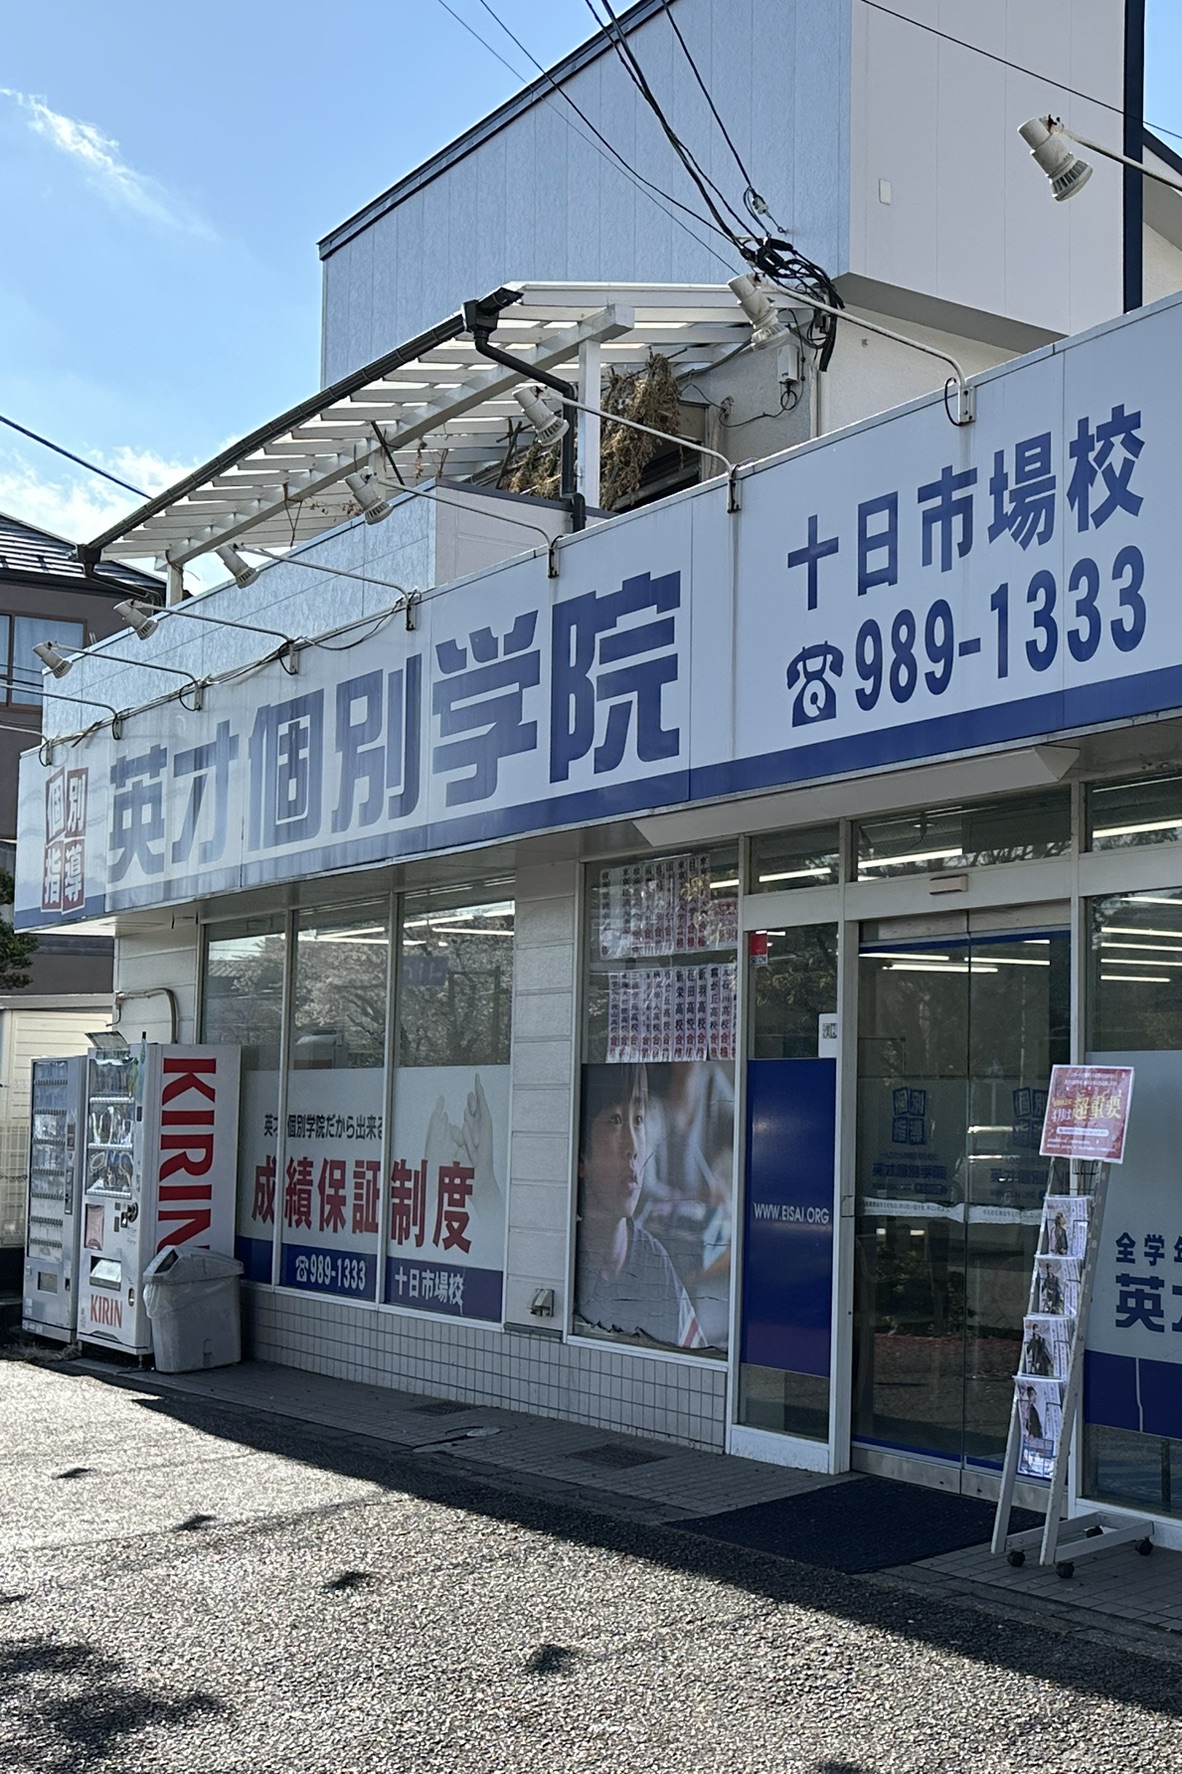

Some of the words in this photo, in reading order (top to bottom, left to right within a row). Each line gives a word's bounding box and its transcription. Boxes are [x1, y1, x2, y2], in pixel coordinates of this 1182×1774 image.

[787, 403, 1146, 611] 十日市場校
[854, 546, 1147, 712] 989-1333
[109, 571, 681, 884] 英才個別学院
[251, 1154, 475, 1254] 成績保証制度
[90, 1294, 123, 1329] KIRIN
[310, 1254, 366, 1291] 989-1333
[394, 1266, 464, 1305] 十日市場校
